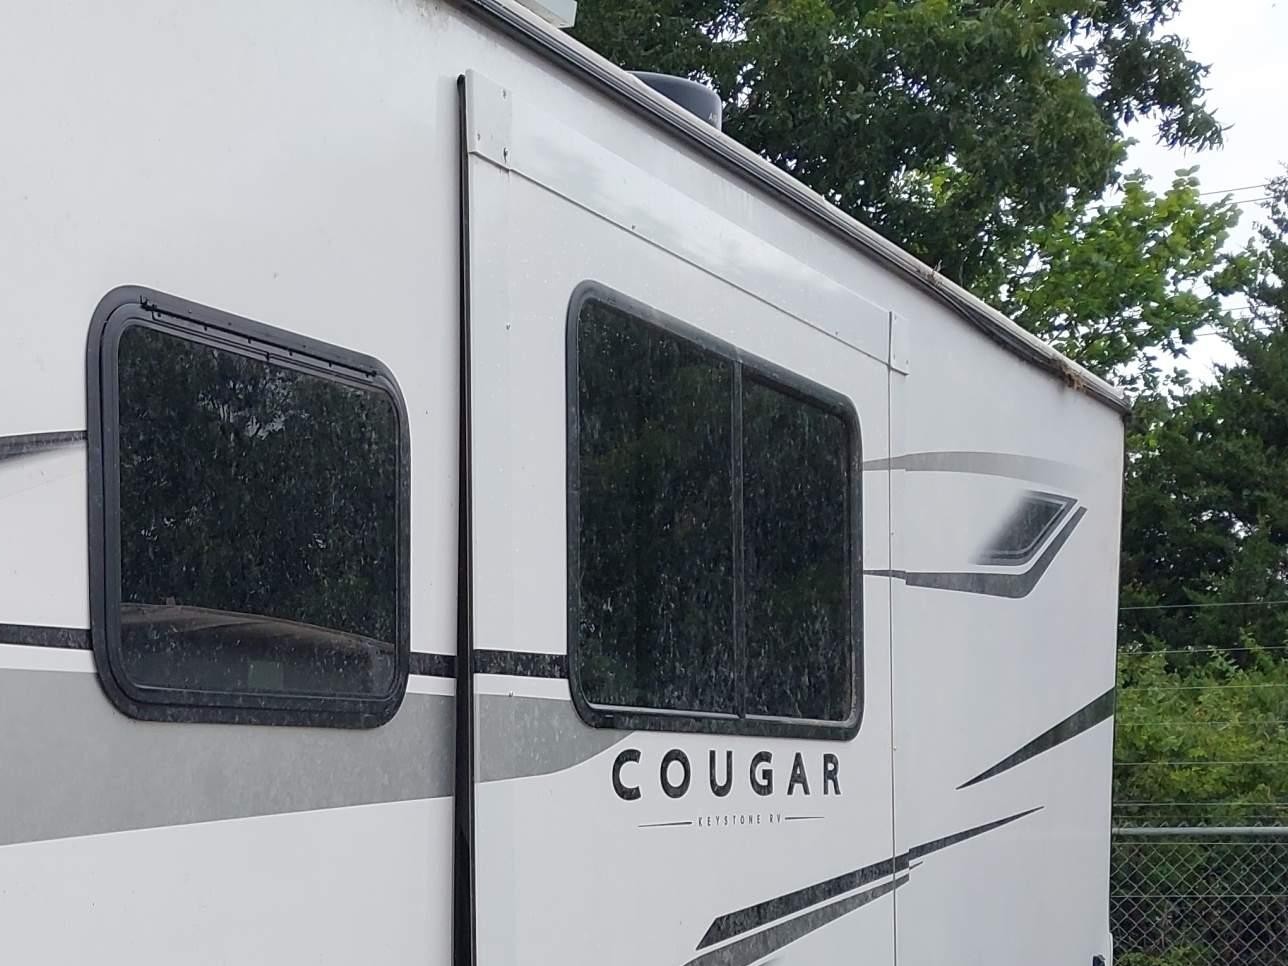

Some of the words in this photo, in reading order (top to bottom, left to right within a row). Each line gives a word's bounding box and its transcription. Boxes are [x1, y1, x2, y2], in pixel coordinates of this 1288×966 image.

[612, 748, 841, 801] COUGAR
[698, 813, 761, 827] KEYSTONE
[769, 813, 781, 824] RV
